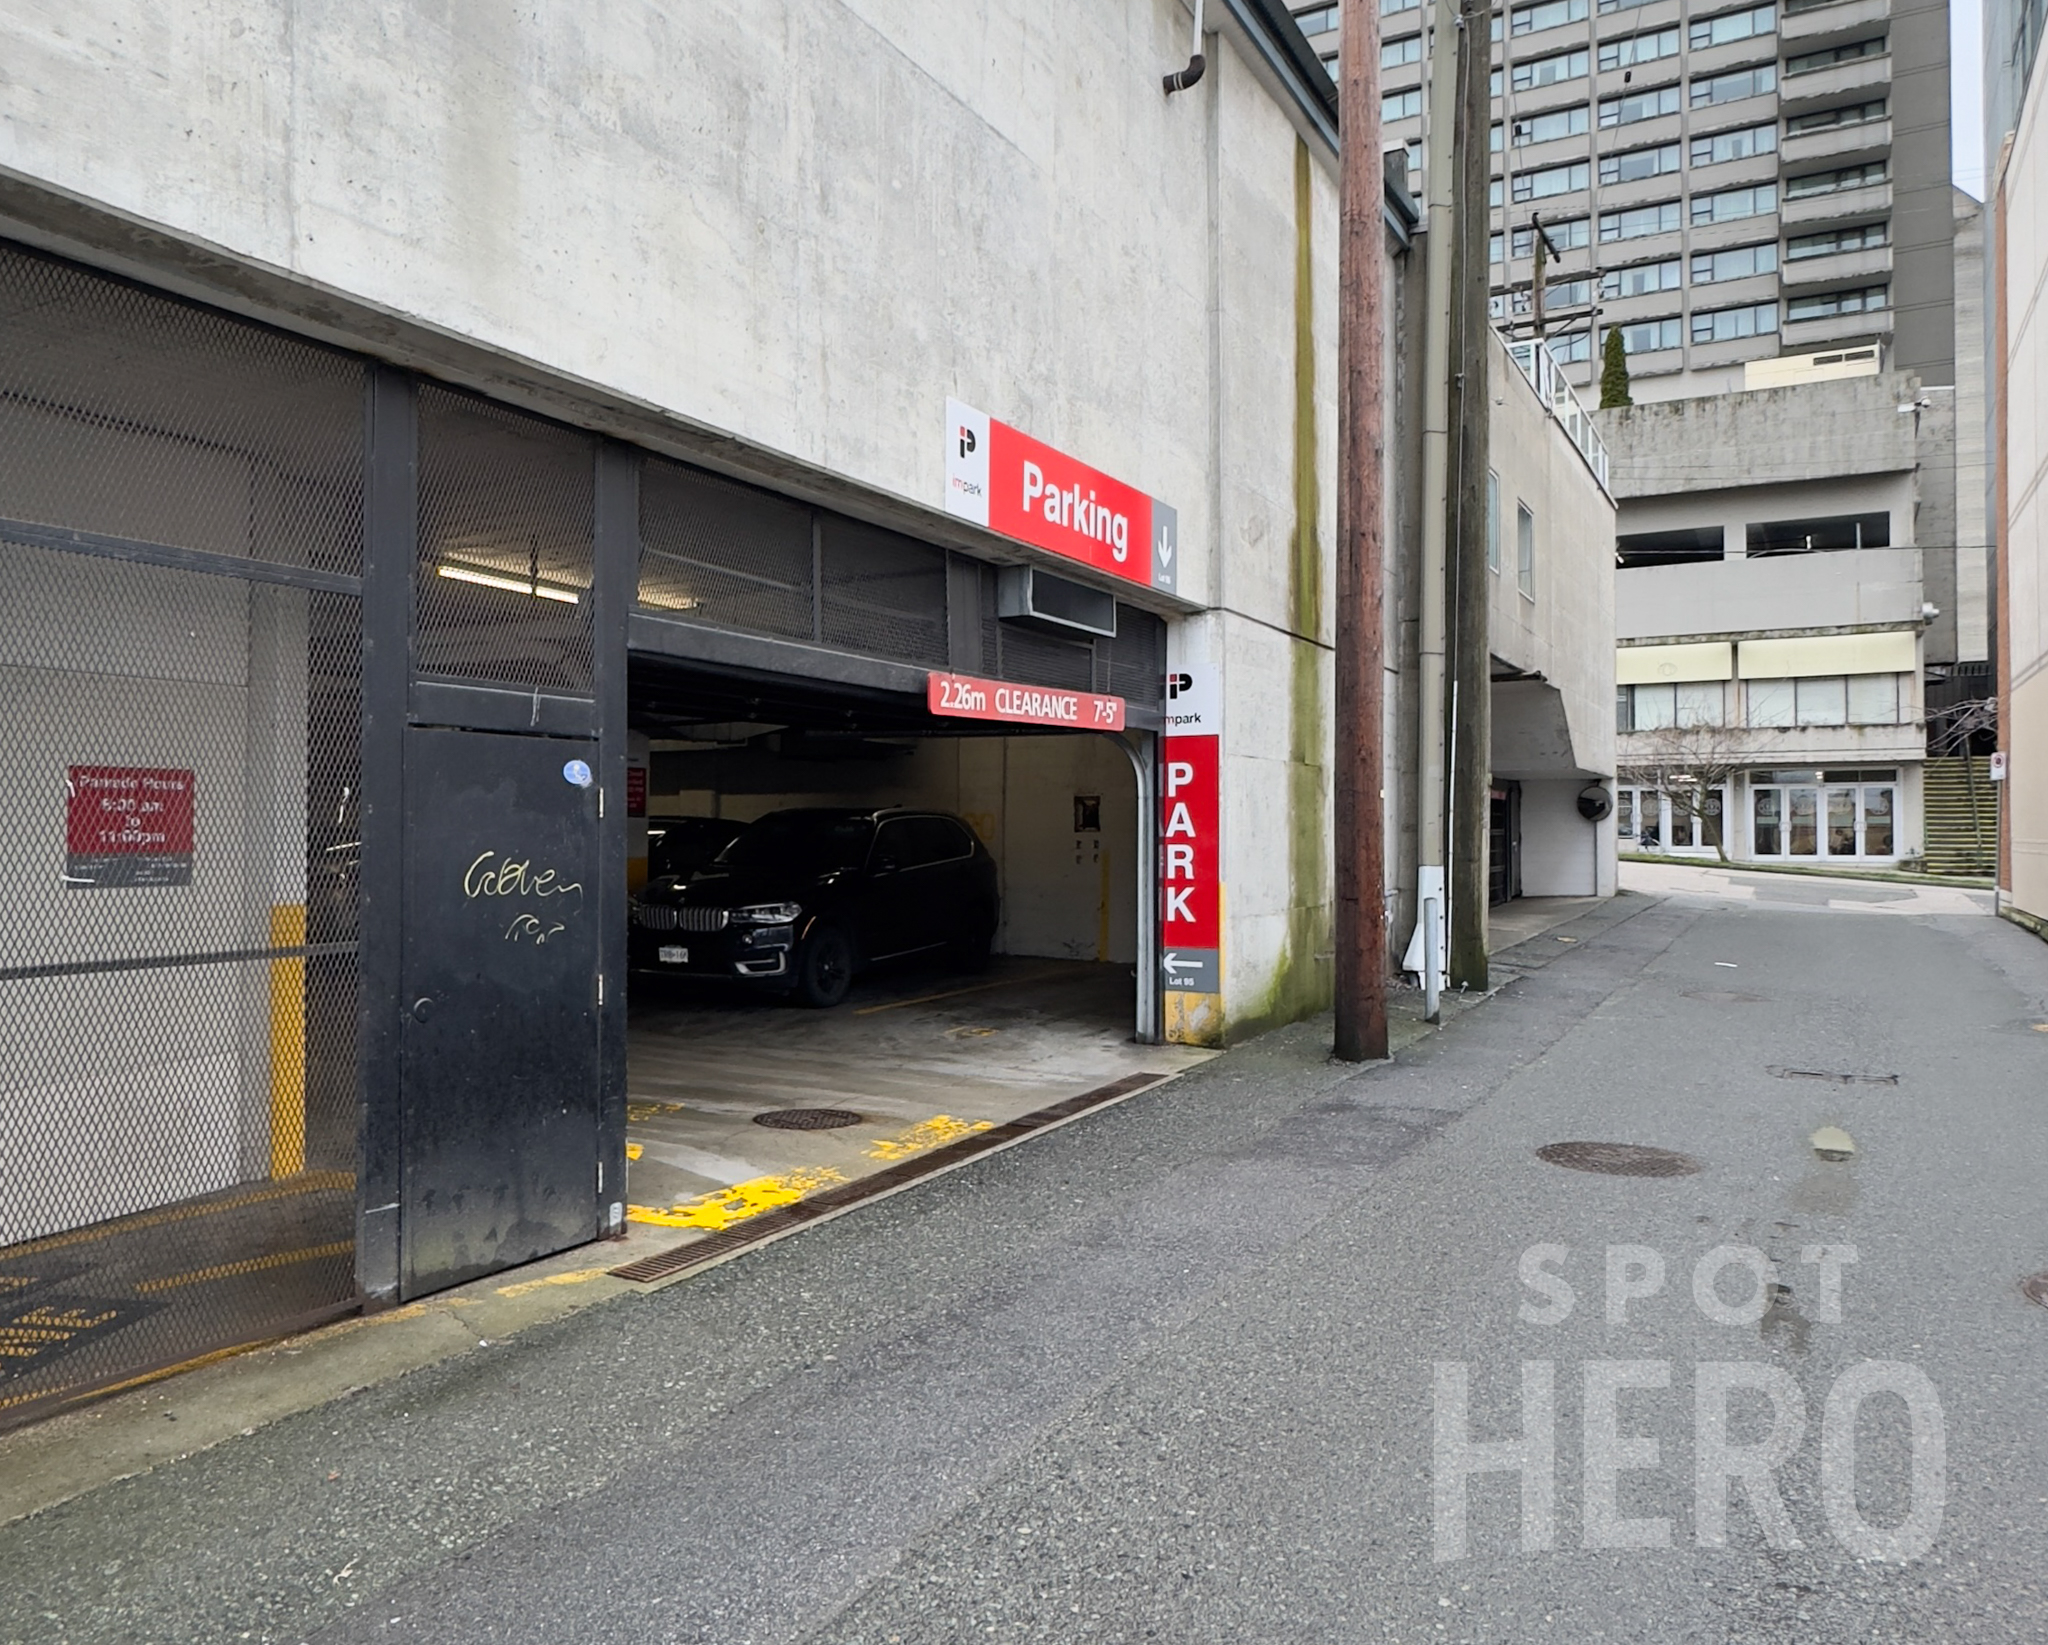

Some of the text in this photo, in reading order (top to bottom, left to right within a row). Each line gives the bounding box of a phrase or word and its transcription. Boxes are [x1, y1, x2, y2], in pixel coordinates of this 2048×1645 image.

[952, 473, 982, 498] impark
[1022, 459, 1129, 563] Parking
[940, 681, 986, 712] 2.26m
[995, 688, 1078, 721] CLEARANCE
[1164, 712, 1202, 727] mpark
[1165, 762, 1197, 924] PARK
[1168, 976, 1182, 986] Lot
